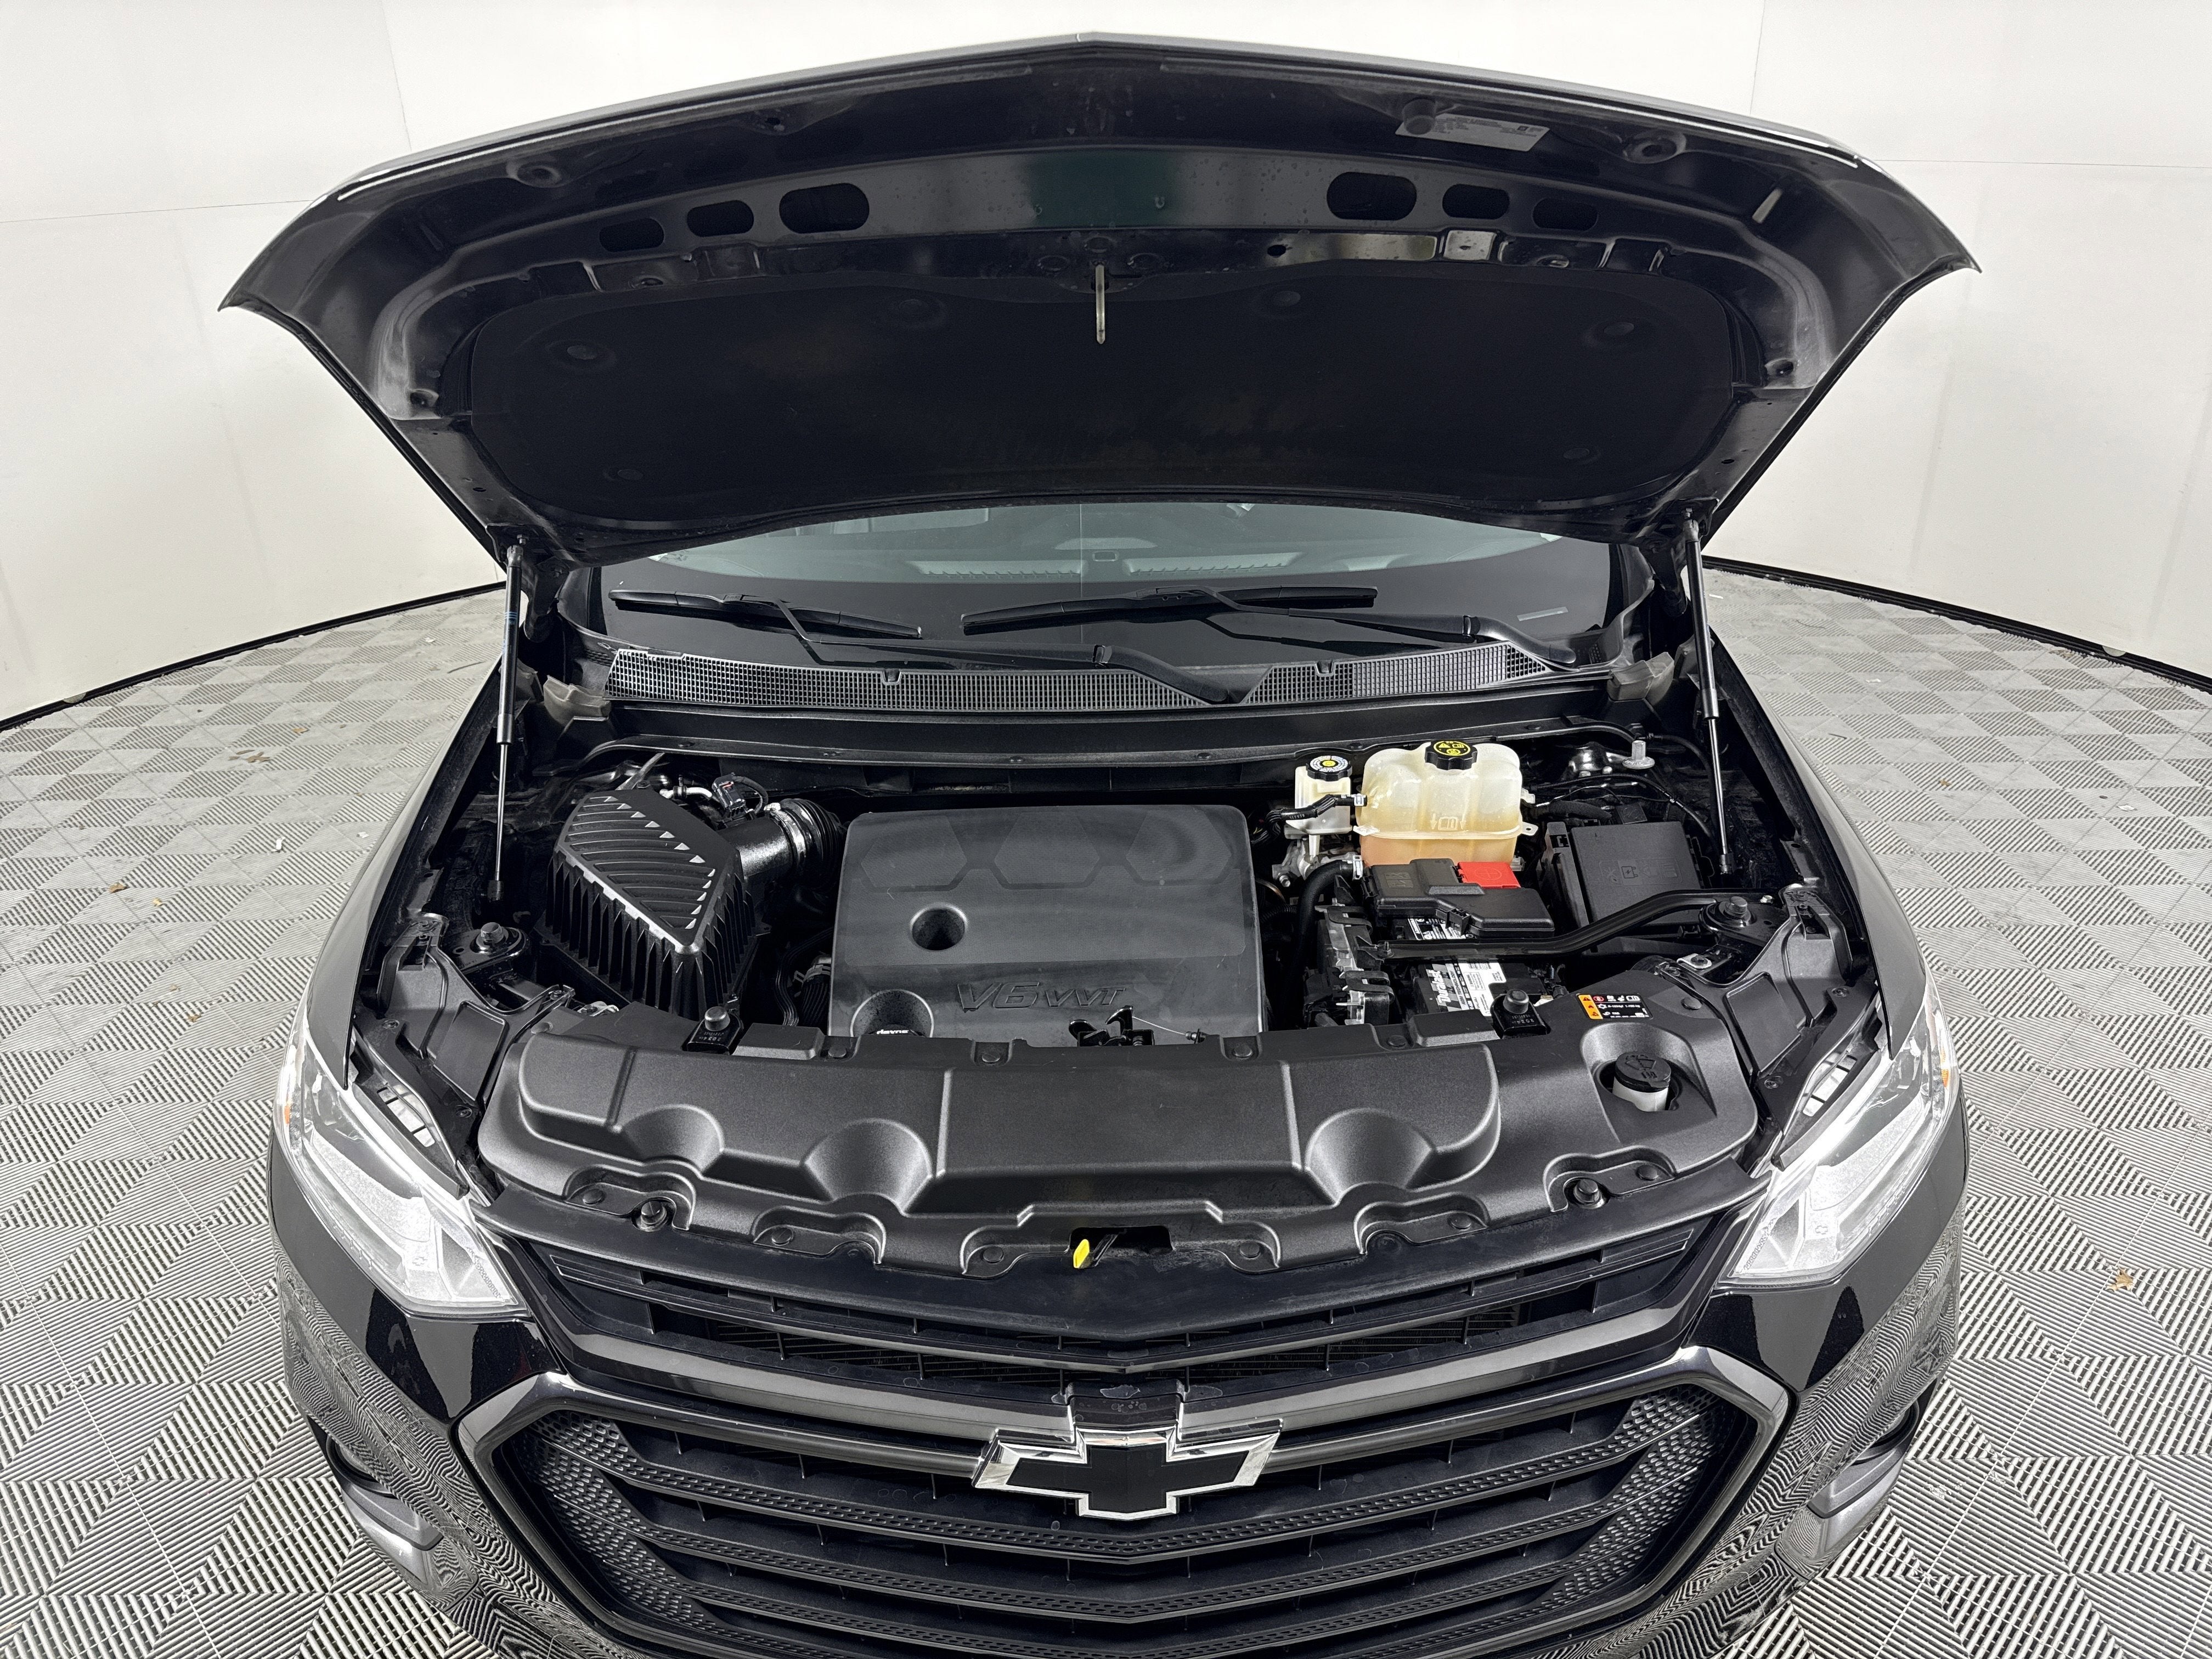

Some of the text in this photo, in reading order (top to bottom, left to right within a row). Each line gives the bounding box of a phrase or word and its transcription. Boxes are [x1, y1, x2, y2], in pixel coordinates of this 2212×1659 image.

[957, 981, 1126, 1011] V6 VVT
[1428, 969, 1452, 1003] Duralast
[1449, 970, 1462, 995] TECHNOLOGY
